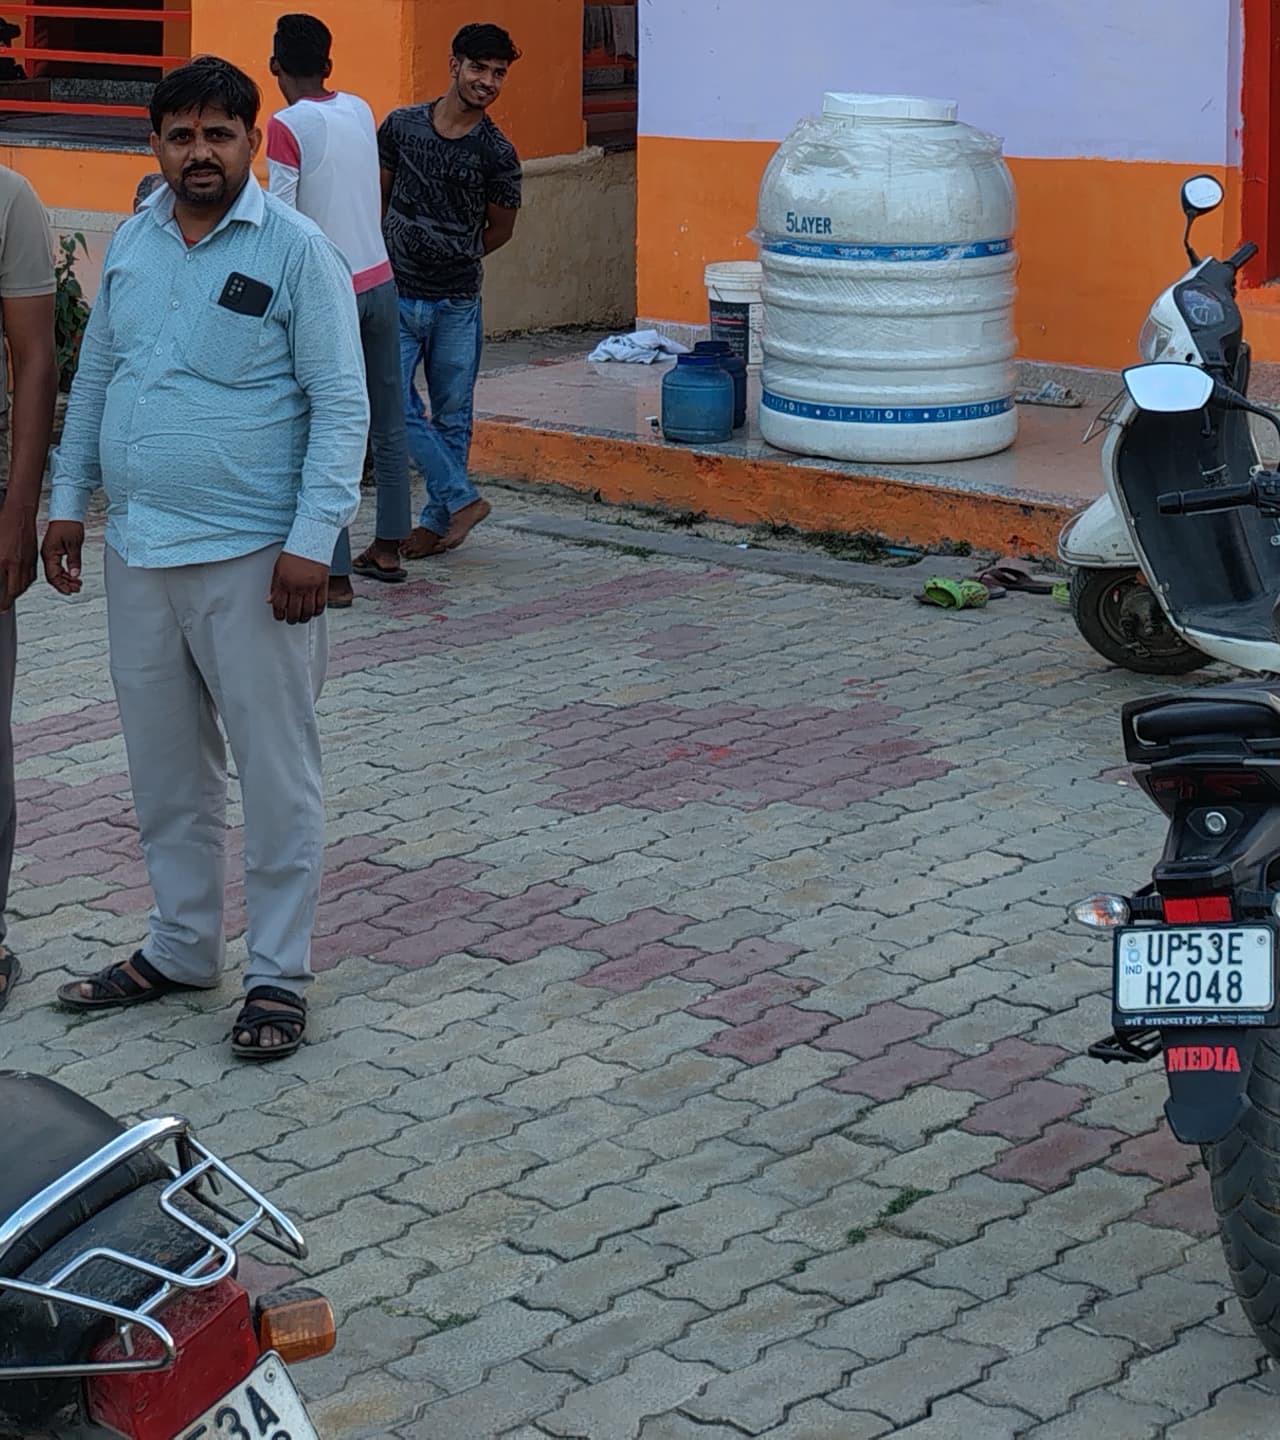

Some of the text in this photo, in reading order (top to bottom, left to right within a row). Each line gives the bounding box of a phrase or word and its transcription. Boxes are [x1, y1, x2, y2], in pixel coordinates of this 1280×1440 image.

[786, 211, 832, 234] 5LAYER
[1147, 932, 1244, 967] UP53E
[1124, 964, 1143, 976] IND
[1146, 970, 1243, 1006] H2048
[1167, 1046, 1241, 1073] MEDIA
